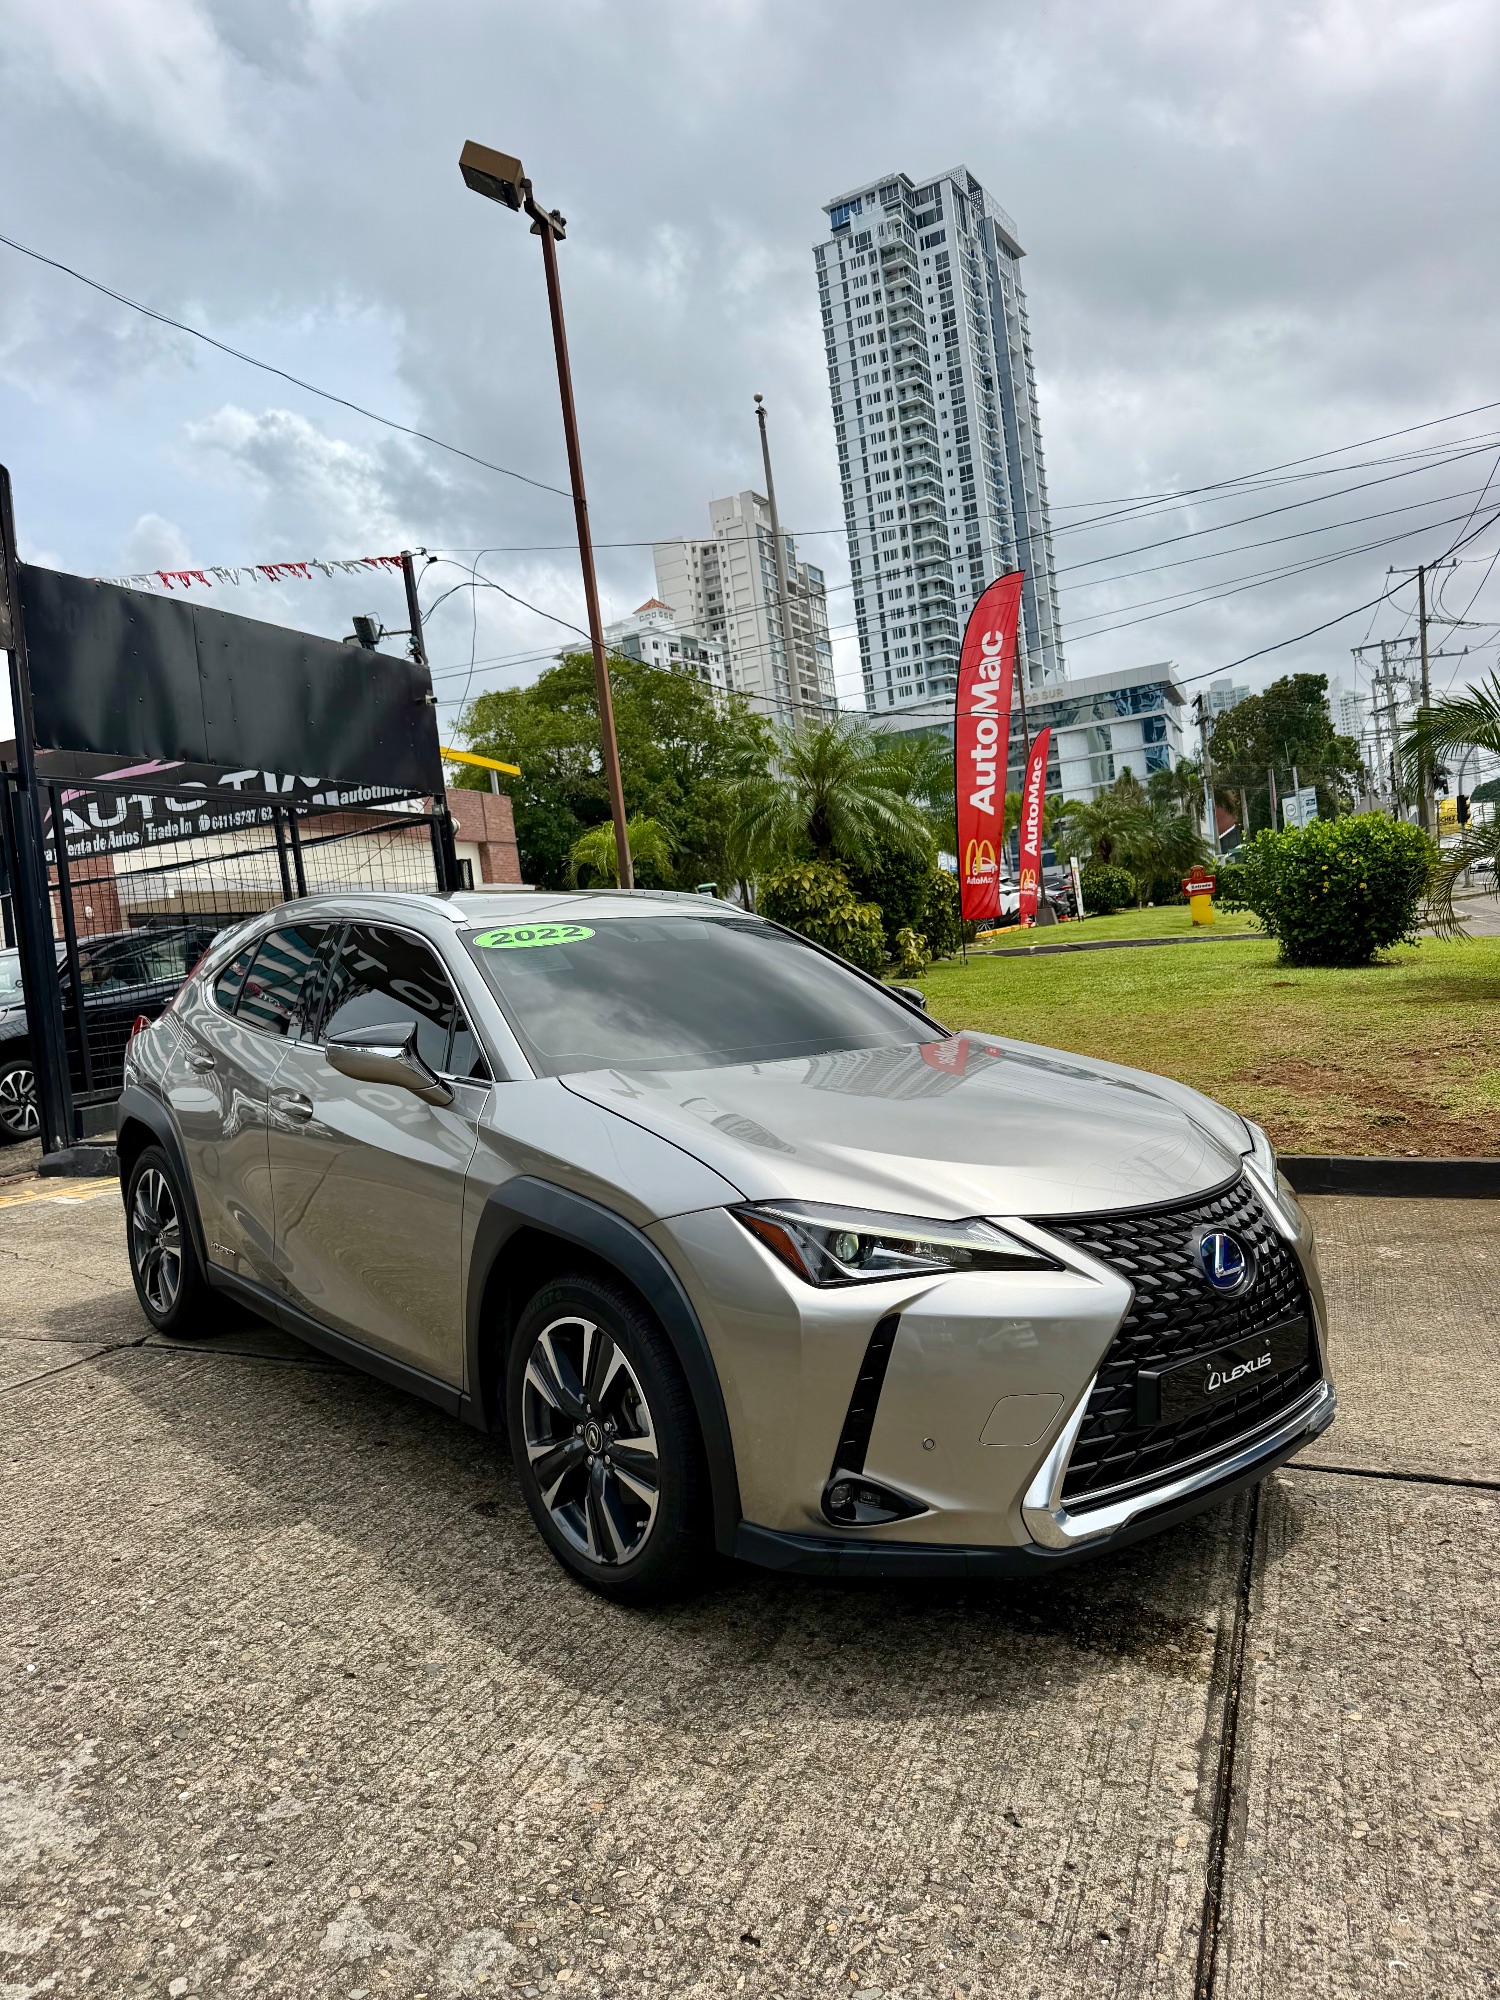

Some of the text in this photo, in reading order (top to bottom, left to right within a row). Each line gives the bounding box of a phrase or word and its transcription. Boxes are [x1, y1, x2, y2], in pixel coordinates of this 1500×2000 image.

[1041, 688, 1064, 700] SUR
[970, 629, 1004, 815] AutoMac
[1024, 756, 1043, 857] AutoMac
[66, 838, 92, 856] enta
[108, 830, 140, 849] Autos
[146, 819, 179, 841] Trade
[490, 926, 584, 946] 2022
[1221, 1352, 1272, 1384] LEXUS
